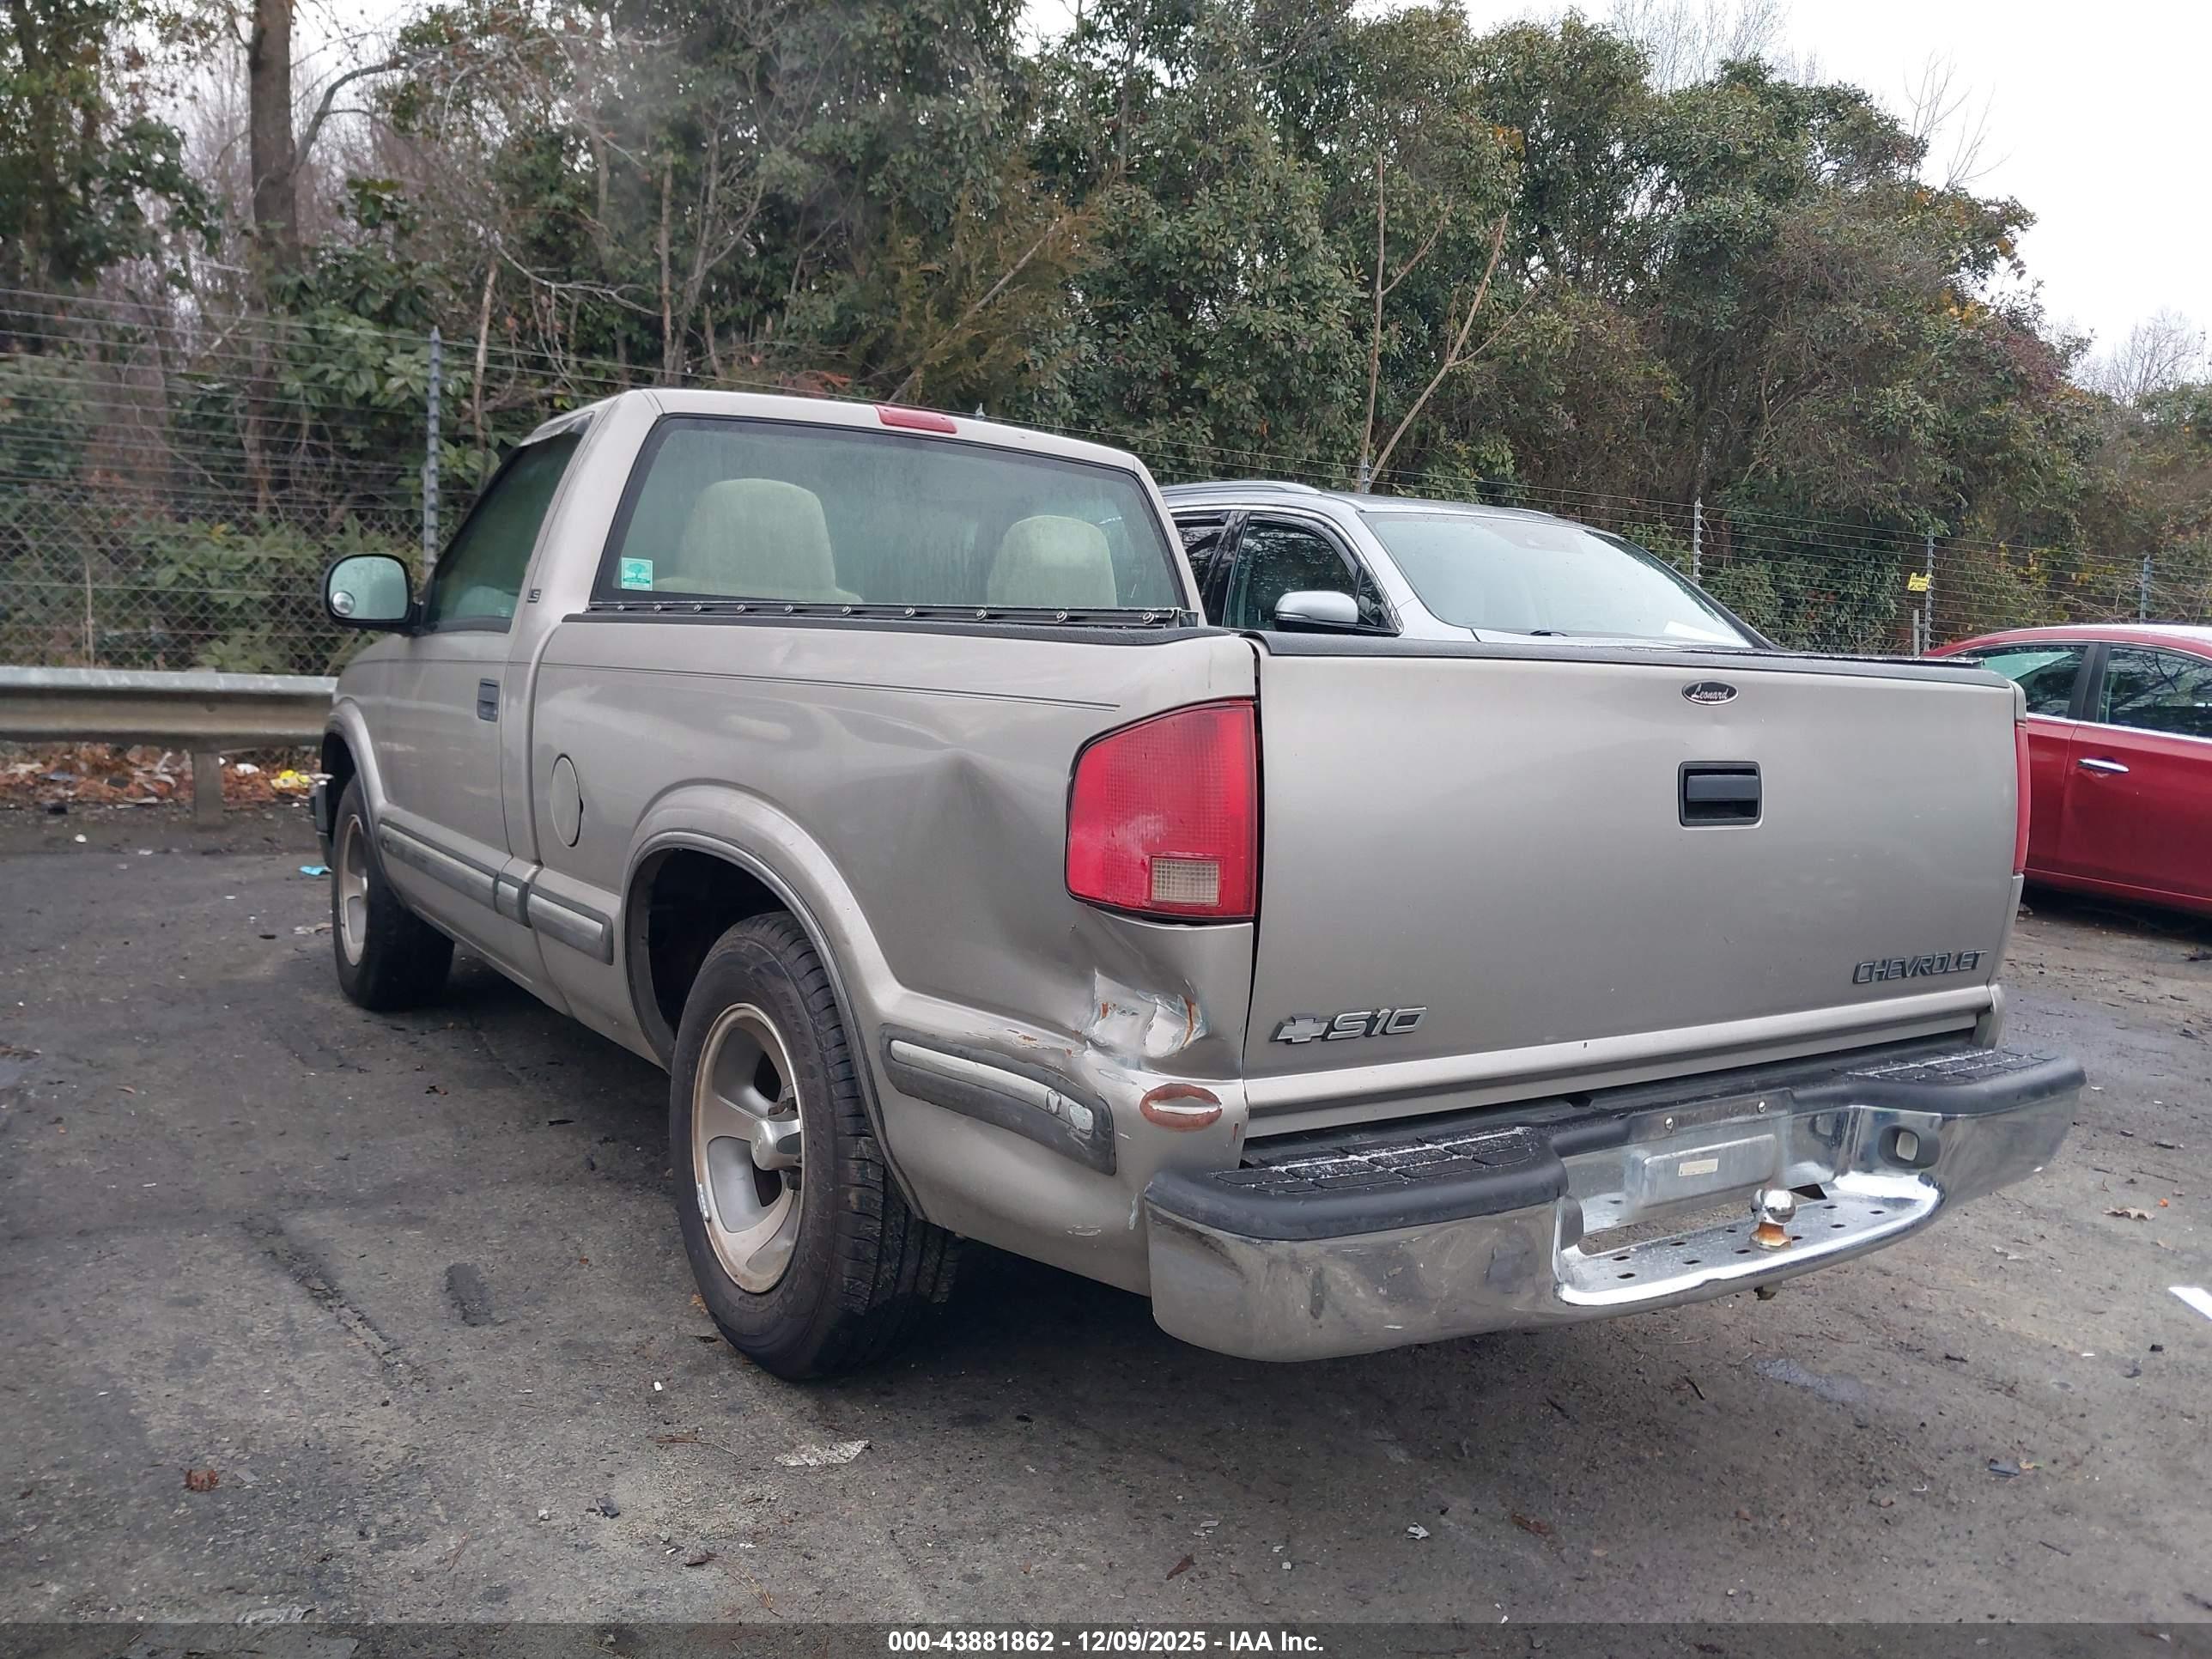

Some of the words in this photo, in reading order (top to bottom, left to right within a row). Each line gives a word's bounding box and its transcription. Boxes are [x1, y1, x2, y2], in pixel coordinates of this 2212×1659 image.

[1691, 683, 1729, 700] Leonard
[1852, 949, 1989, 984] CHEVROLET
[1323, 1006, 1428, 1042] S10
